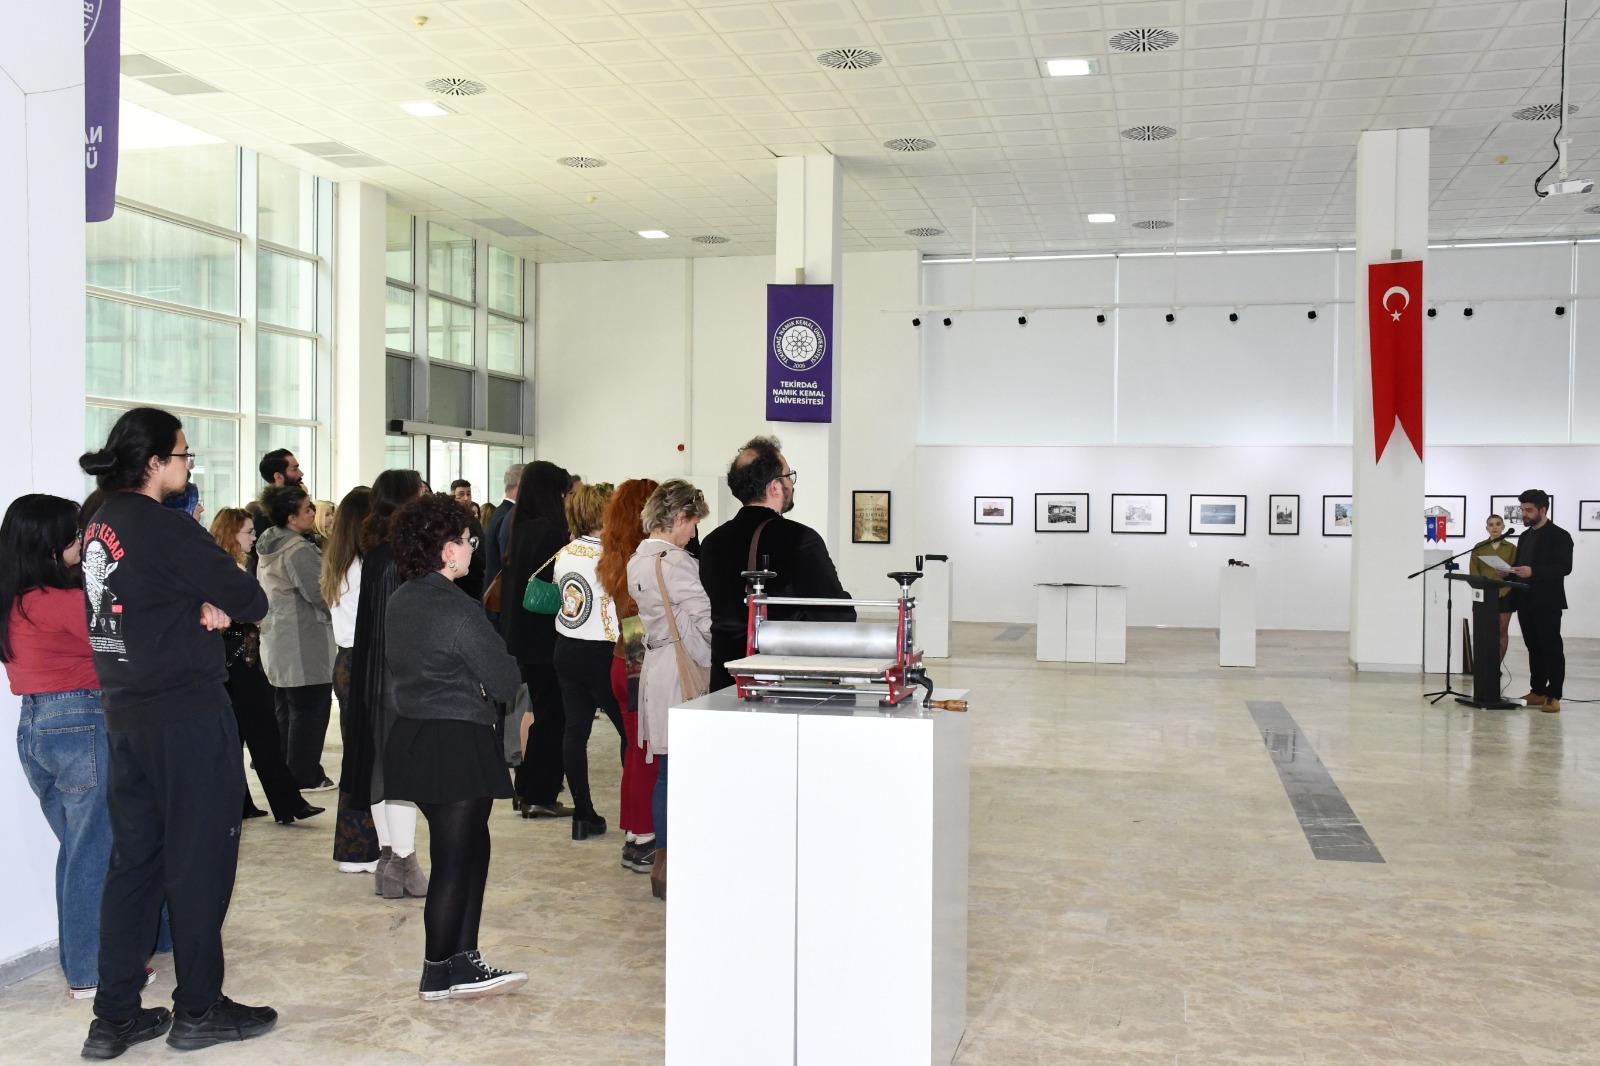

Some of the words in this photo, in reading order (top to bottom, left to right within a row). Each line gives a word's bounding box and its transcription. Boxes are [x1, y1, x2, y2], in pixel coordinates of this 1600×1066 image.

[796, 320, 814, 329] KEMAL
[780, 380, 818, 388] TEKİRDAĞ
[774, 396, 824, 405] ÜNİVERSİTESİ
[98, 522, 125, 561] KEBAB
